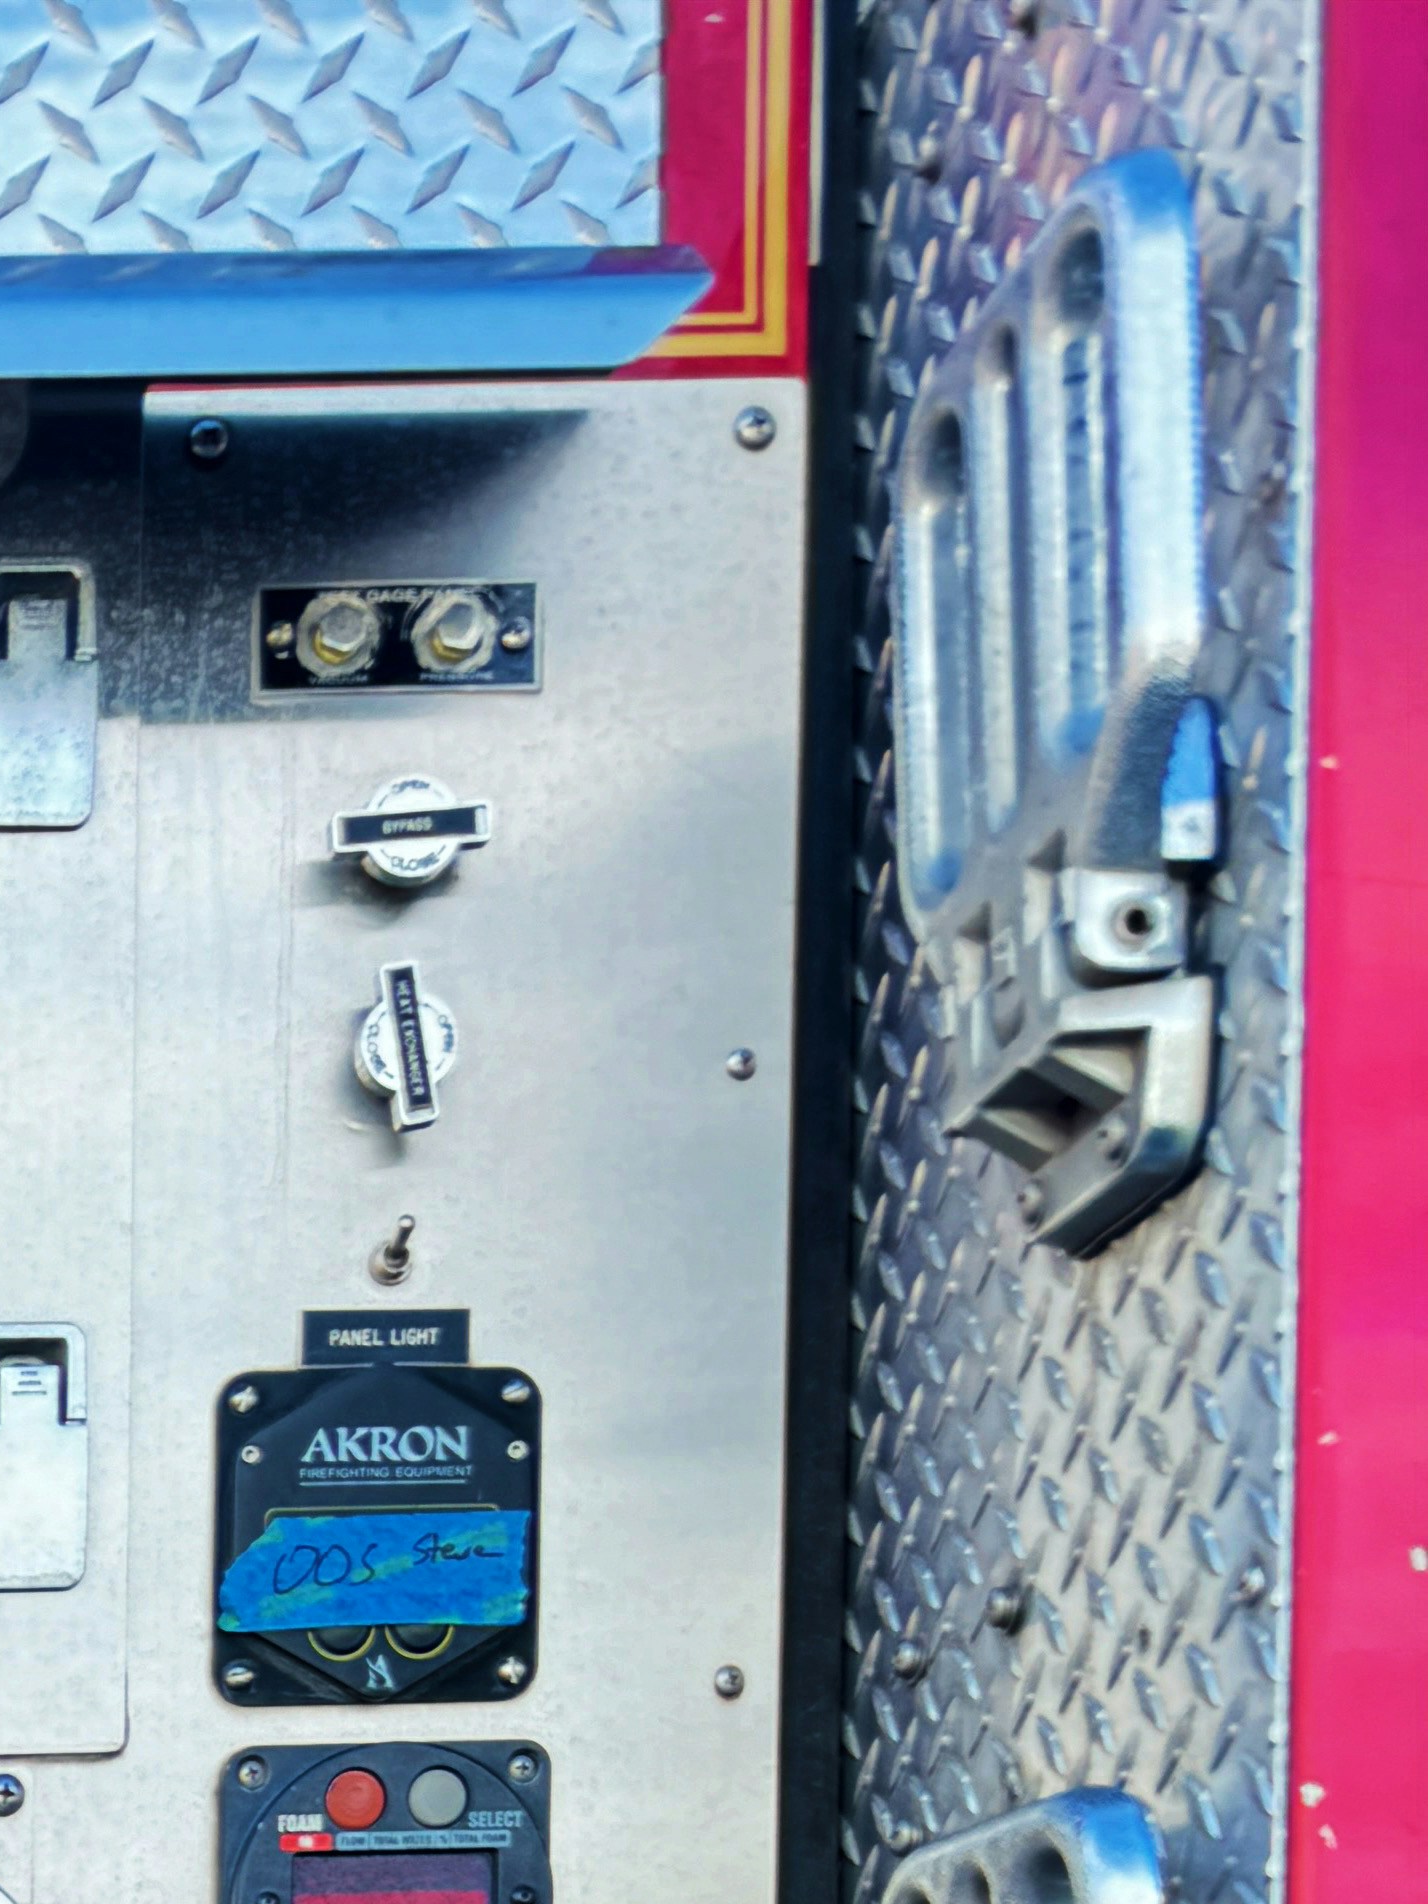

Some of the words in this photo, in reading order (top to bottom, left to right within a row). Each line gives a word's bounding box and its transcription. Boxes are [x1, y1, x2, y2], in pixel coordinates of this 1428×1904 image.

[329, 1329, 384, 1346] PANEL
[389, 1327, 440, 1344] LIGHT
[301, 1426, 469, 1462] AKRON
